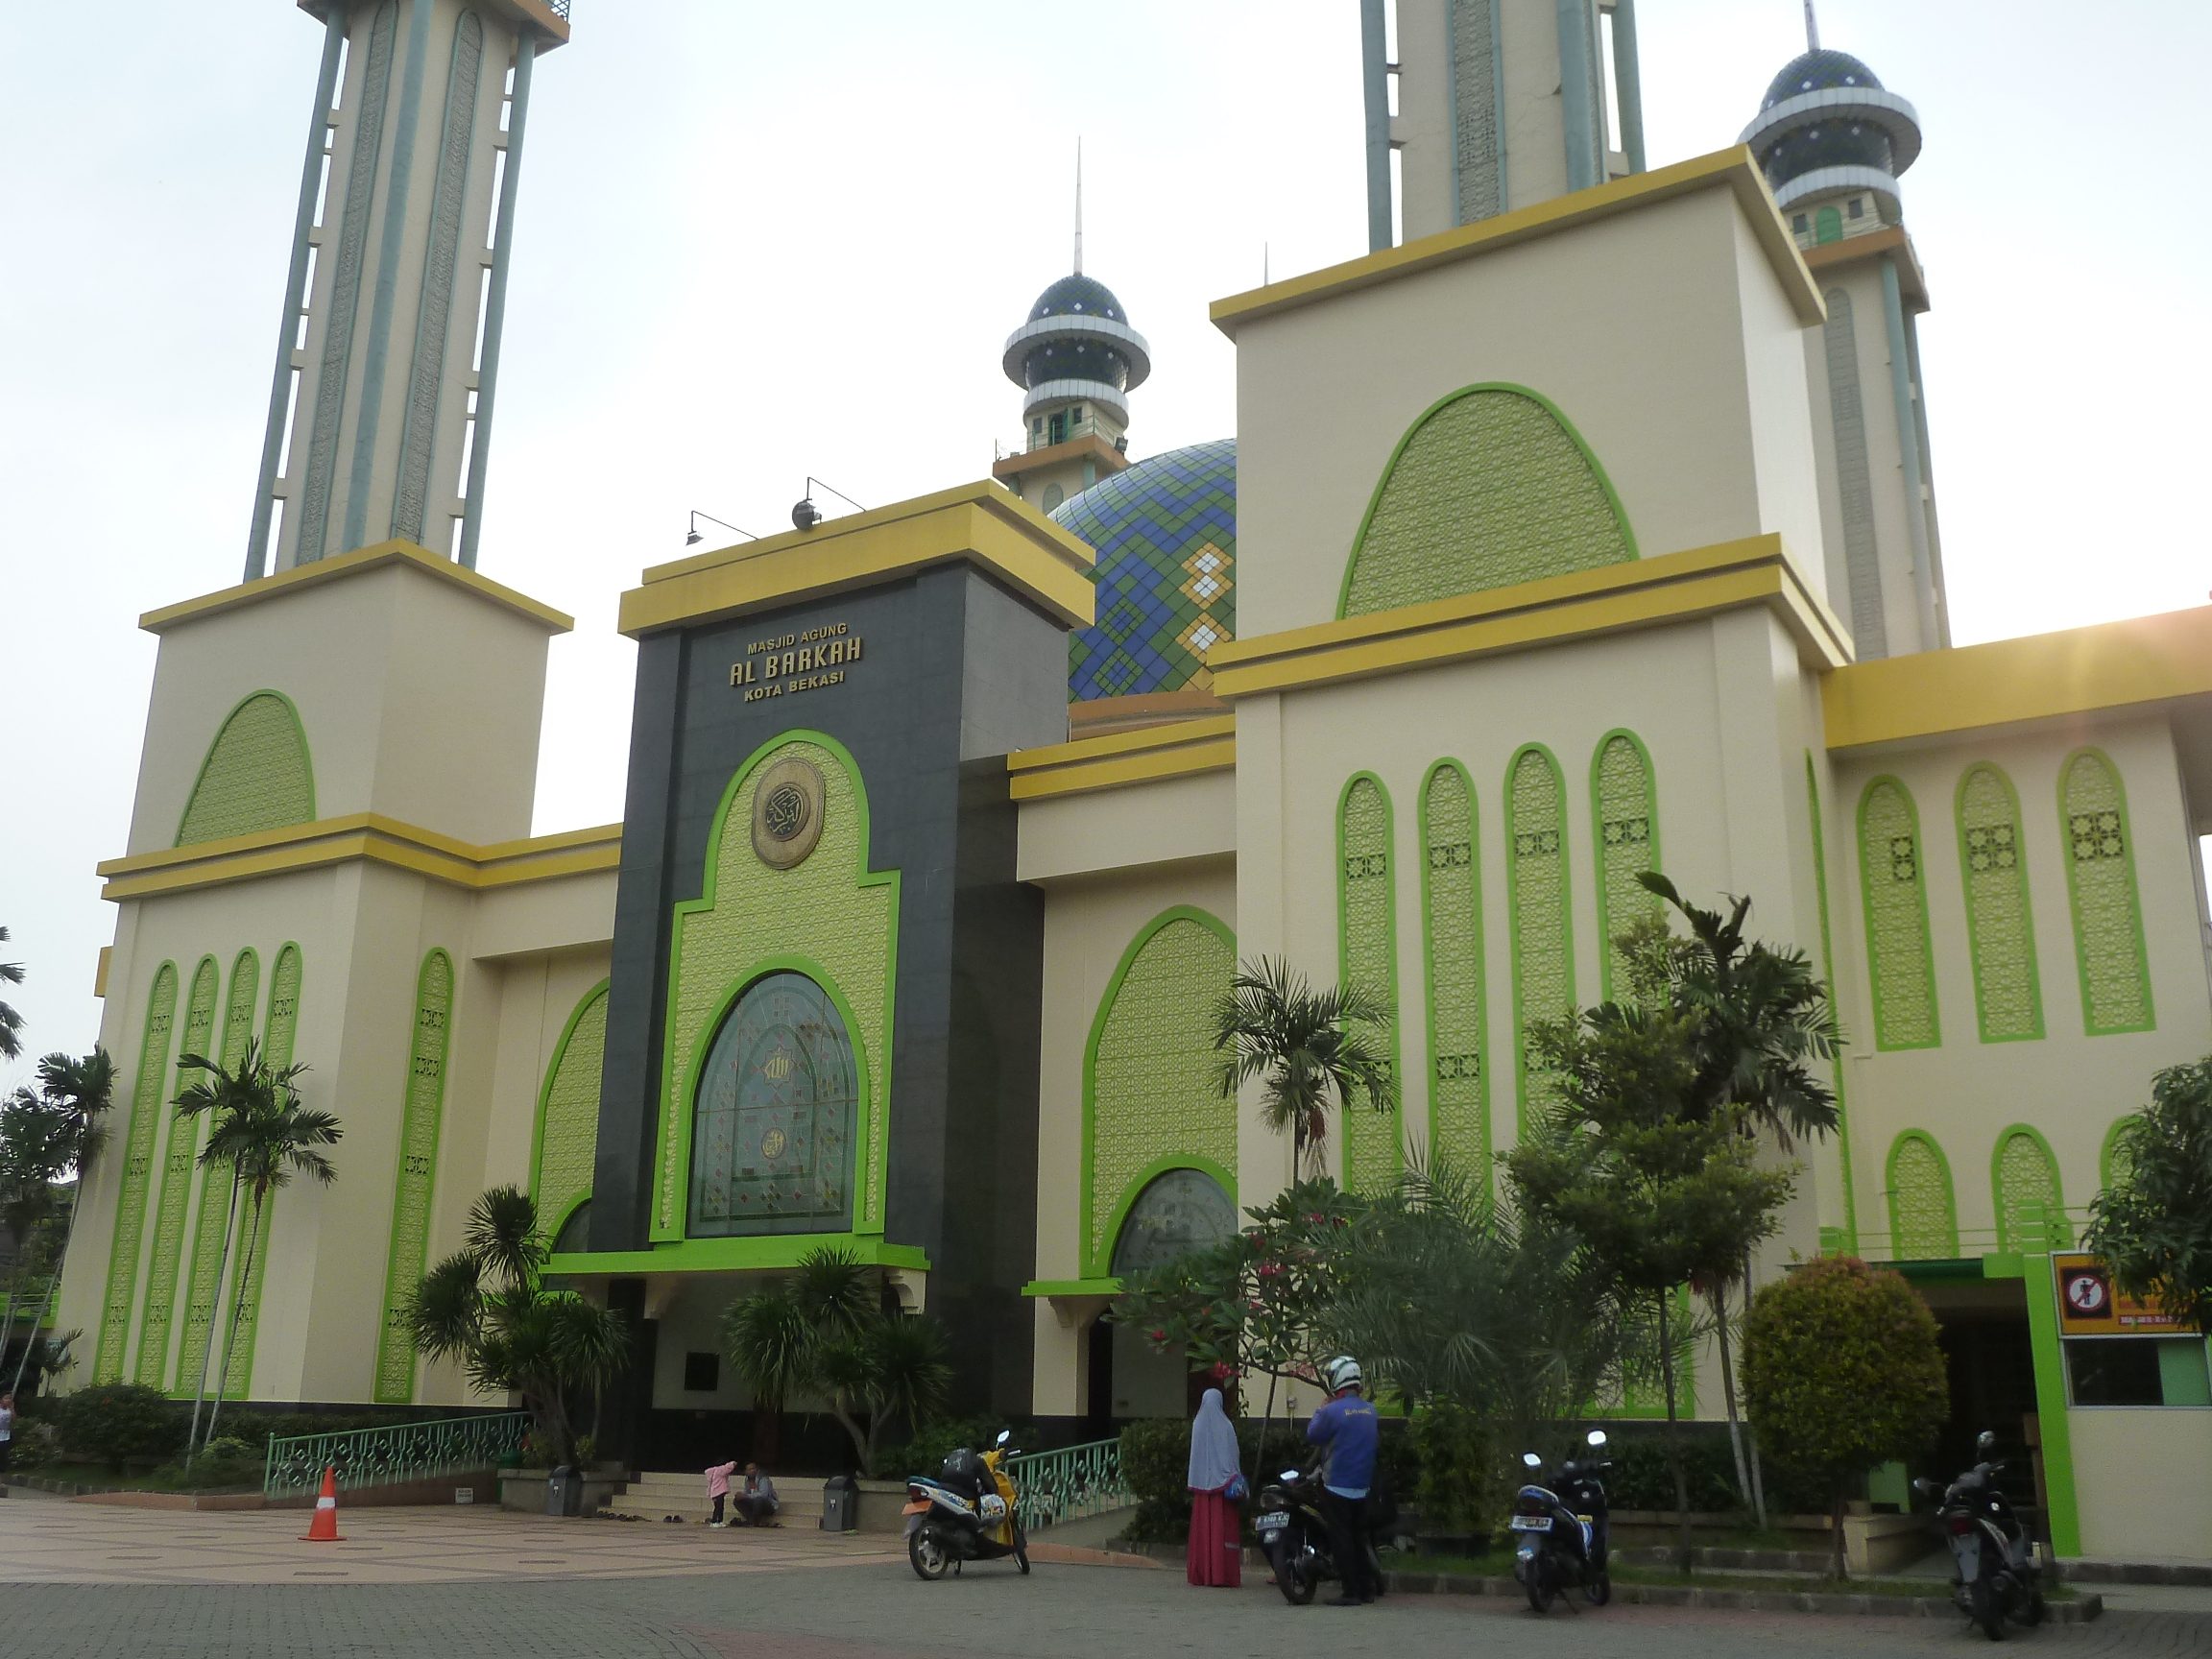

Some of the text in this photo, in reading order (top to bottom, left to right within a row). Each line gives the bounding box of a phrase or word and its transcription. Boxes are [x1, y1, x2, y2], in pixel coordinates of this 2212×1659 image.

[747, 622, 848, 655] MASJID AGUNG
[730, 637, 861, 685] AL BARKAH
[744, 670, 845, 702] KOTA BEKASI
